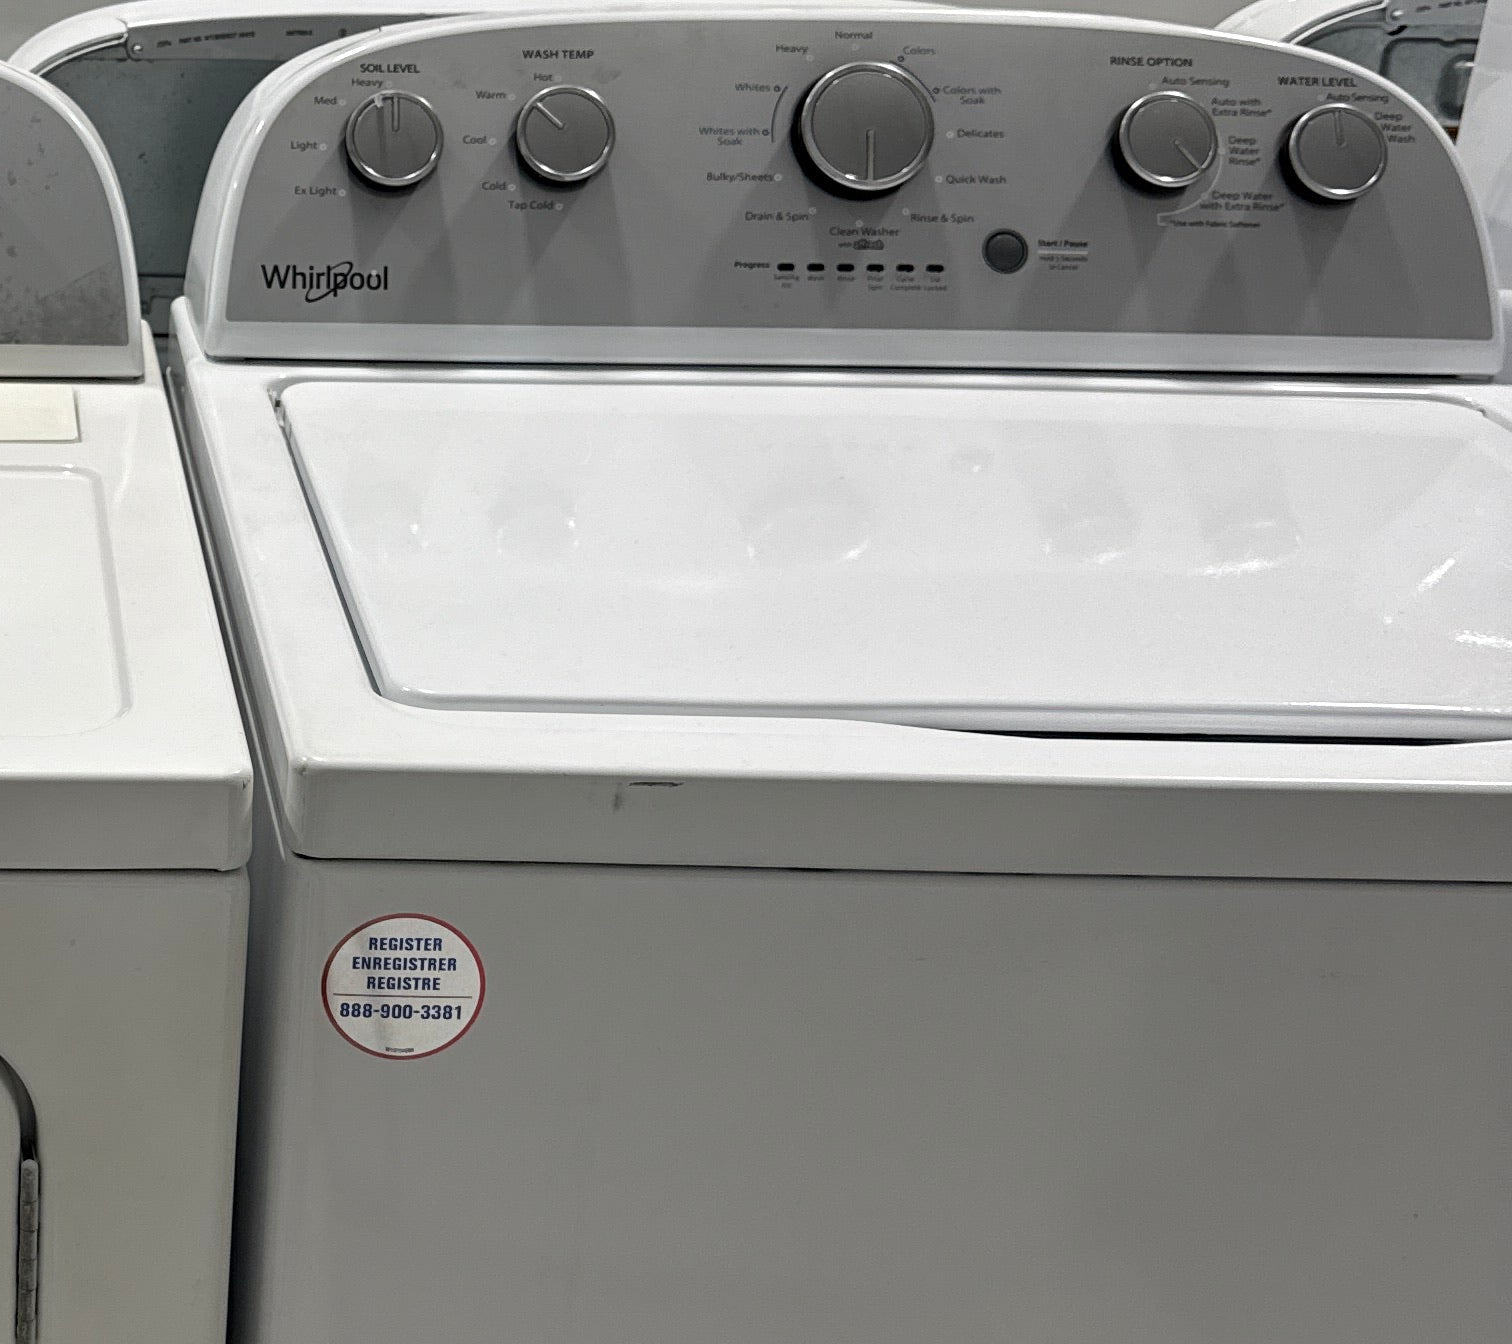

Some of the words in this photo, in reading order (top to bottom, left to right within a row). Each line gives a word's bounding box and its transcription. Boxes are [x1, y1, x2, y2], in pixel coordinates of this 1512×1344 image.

[835, 30, 874, 40] Normal
[775, 43, 809, 55] Heavy
[902, 45, 937, 56] Colors
[522, 50, 559, 60] WASH
[561, 50, 595, 60] TEMP
[1110, 56, 1144, 67] RINSE
[1146, 57, 1193, 67] OPTION
[359, 63, 385, 73] SOIL
[387, 64, 420, 74] LEVEL
[351, 77, 384, 88] Heavy
[533, 73, 553, 82] Hot
[1162, 76, 1187, 86] Auto
[1189, 76, 1230, 89] Sensing
[1278, 77, 1319, 87] WATER
[1321, 77, 1357, 88] LEVEL
[734, 82, 771, 93] Whites
[942, 85, 977, 95] Colors
[978, 86, 1002, 95] with
[313, 96, 338, 105] Med
[476, 90, 507, 100] Warm
[959, 95, 985, 105] Soak
[1326, 93, 1351, 101] Auto
[1352, 93, 1389, 104] Sensing
[1211, 97, 1237, 106] Auto
[1239, 97, 1262, 106] with
[1212, 108, 1238, 116] Extra
[1374, 112, 1403, 123] Deep
[698, 126, 735, 136] Whites
[737, 127, 761, 136] with
[956, 127, 1005, 139] Delicates
[1383, 123, 1412, 132] Water
[462, 134, 487, 145] Cool
[717, 136, 743, 146] Soak
[1228, 136, 1257, 146] Deep
[1387, 135, 1415, 144] Wash
[290, 141, 319, 152] Light
[1229, 146, 1260, 155] Water
[706, 171, 775, 183] Bulky/Sheets
[945, 173, 977, 185] Quick
[978, 174, 1008, 185] Wash
[294, 185, 307, 195] Ex
[309, 186, 338, 197] Light
[481, 181, 507, 191] Cold
[1211, 191, 1240, 202] Deep
[1242, 191, 1273, 201] Water
[508, 200, 528, 212] Tap
[529, 200, 555, 211] Cold
[1199, 202, 1223, 211] with
[1225, 202, 1251, 211] Extra
[744, 210, 773, 222] Drain
[775, 211, 783, 221] &
[785, 212, 809, 223] Spin
[910, 213, 939, 223] Rinse
[950, 214, 975, 225] Spin
[829, 226, 859, 237] Clean
[860, 226, 900, 237] Washer
[734, 261, 770, 271] Progress
[260, 264, 388, 297] Whirlpool
[369, 937, 443, 952] REGISTER
[352, 956, 457, 972] ENREGISTRER
[367, 976, 441, 991] REGISTRE
[339, 1002, 463, 1020] 888-900-3381
